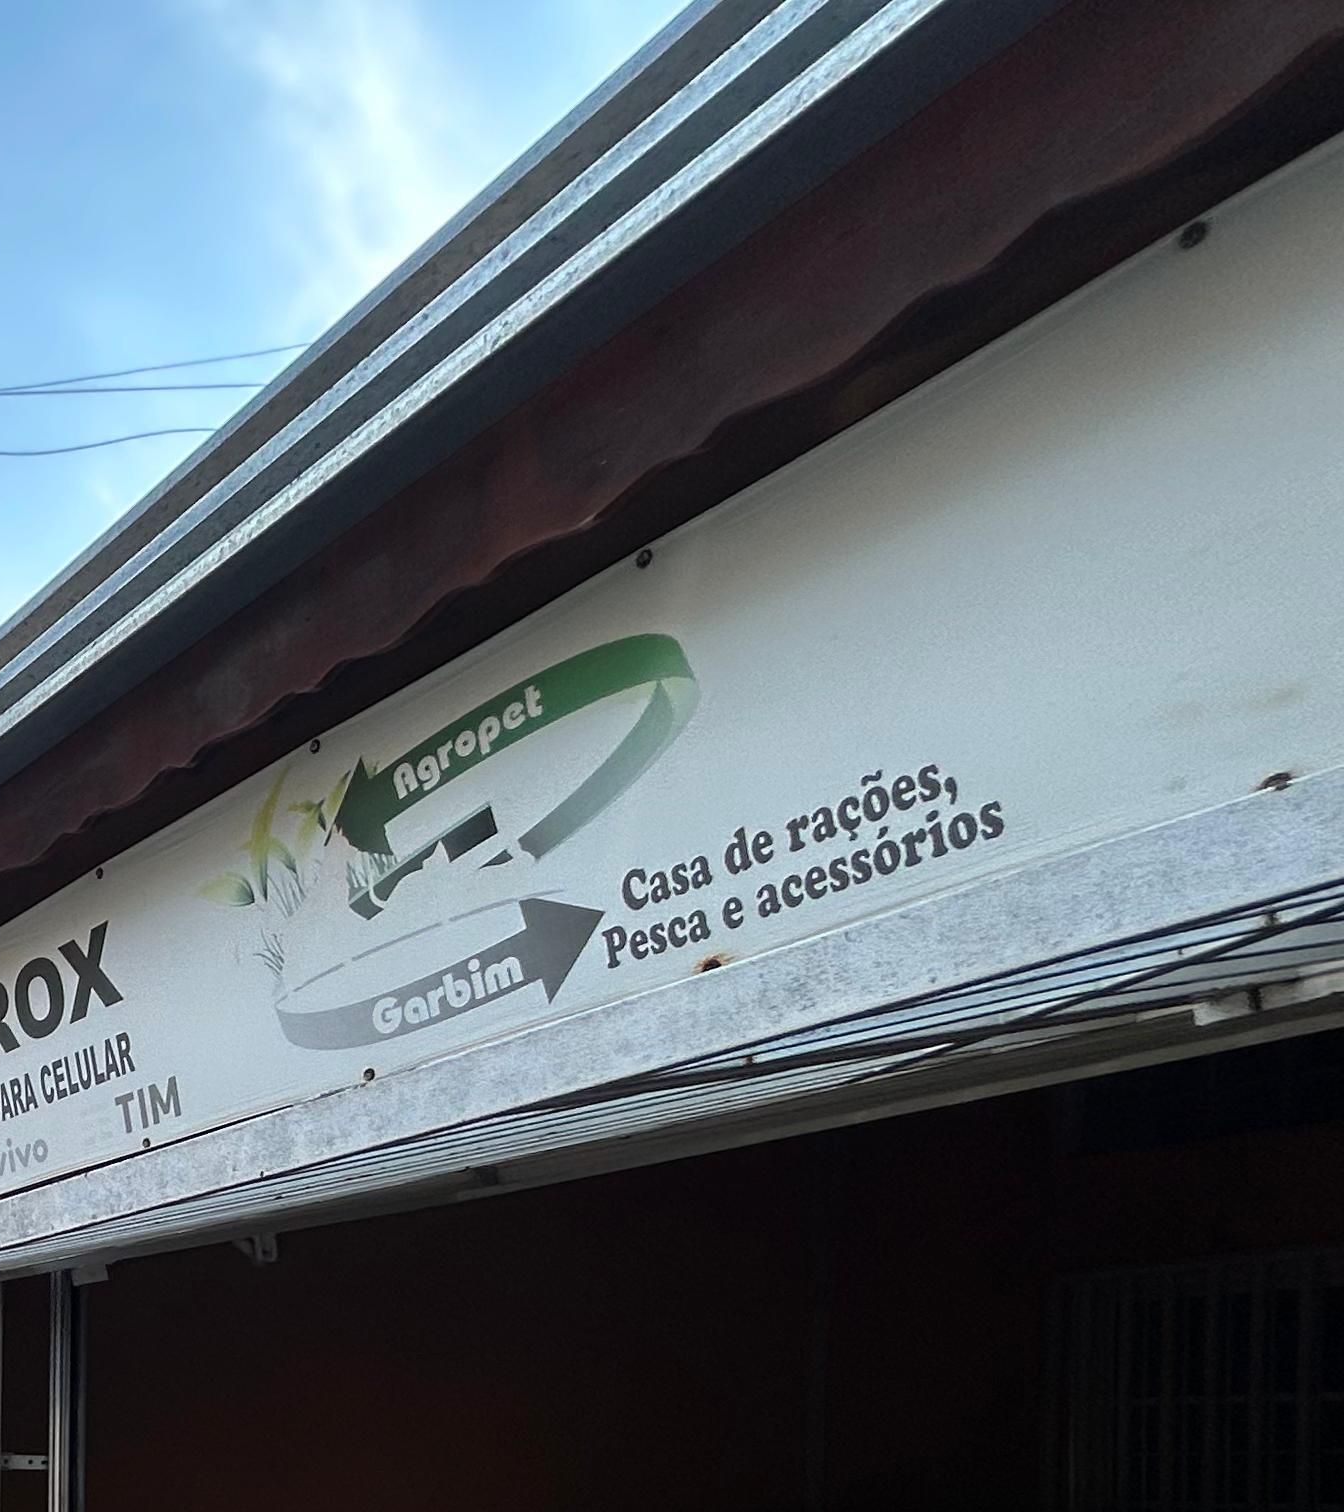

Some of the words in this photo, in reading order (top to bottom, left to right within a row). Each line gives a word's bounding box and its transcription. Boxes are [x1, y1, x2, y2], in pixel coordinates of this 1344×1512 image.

[393, 684, 544, 800] Agropet
[601, 911, 712, 969] Pesca
[722, 895, 745, 930] e
[757, 797, 1007, 921] acessórios
[621, 854, 712, 911] Casa
[724, 826, 775, 877] de
[788, 763, 959, 853] rações,
[372, 949, 524, 1037] Garbim
[39, 1031, 136, 1106] CELULAR
[115, 1076, 182, 1133] TIM
